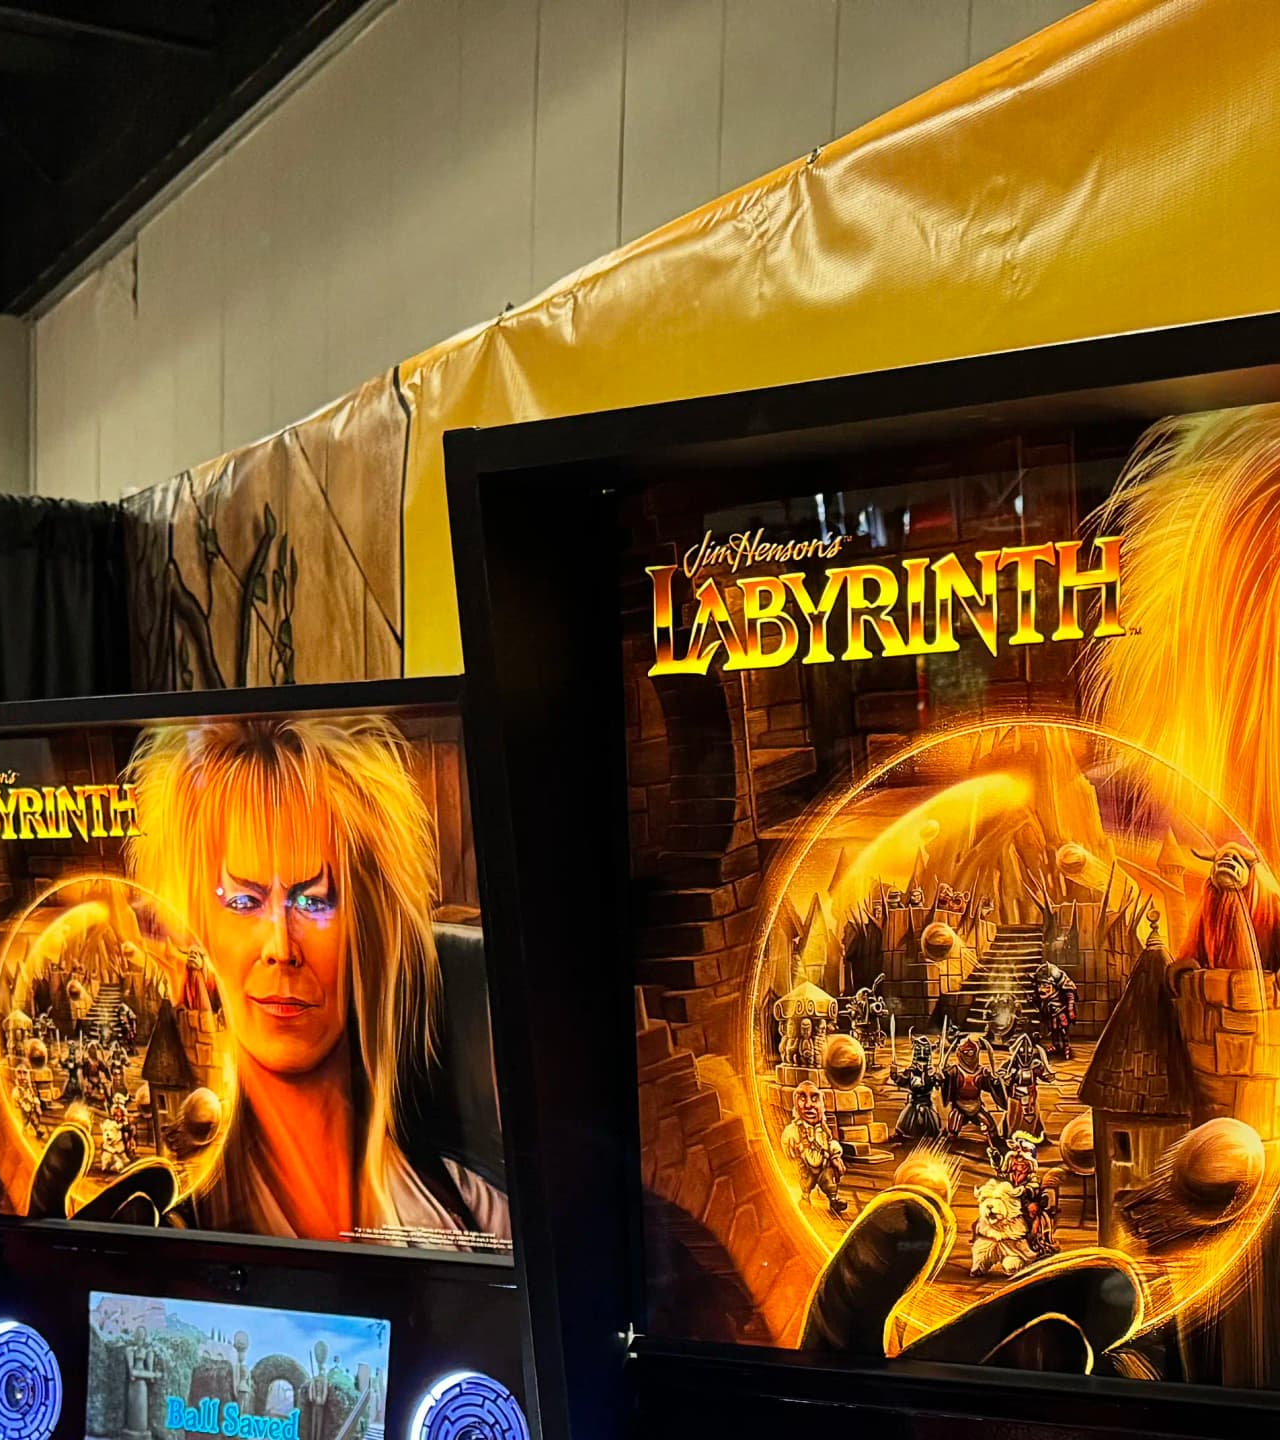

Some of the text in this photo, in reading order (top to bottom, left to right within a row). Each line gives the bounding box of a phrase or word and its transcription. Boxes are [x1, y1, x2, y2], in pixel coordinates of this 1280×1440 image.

[683, 529, 735, 578] Jim
[644, 535, 1127, 677] LABYRINTH
[166, 1395, 219, 1434] Ball
